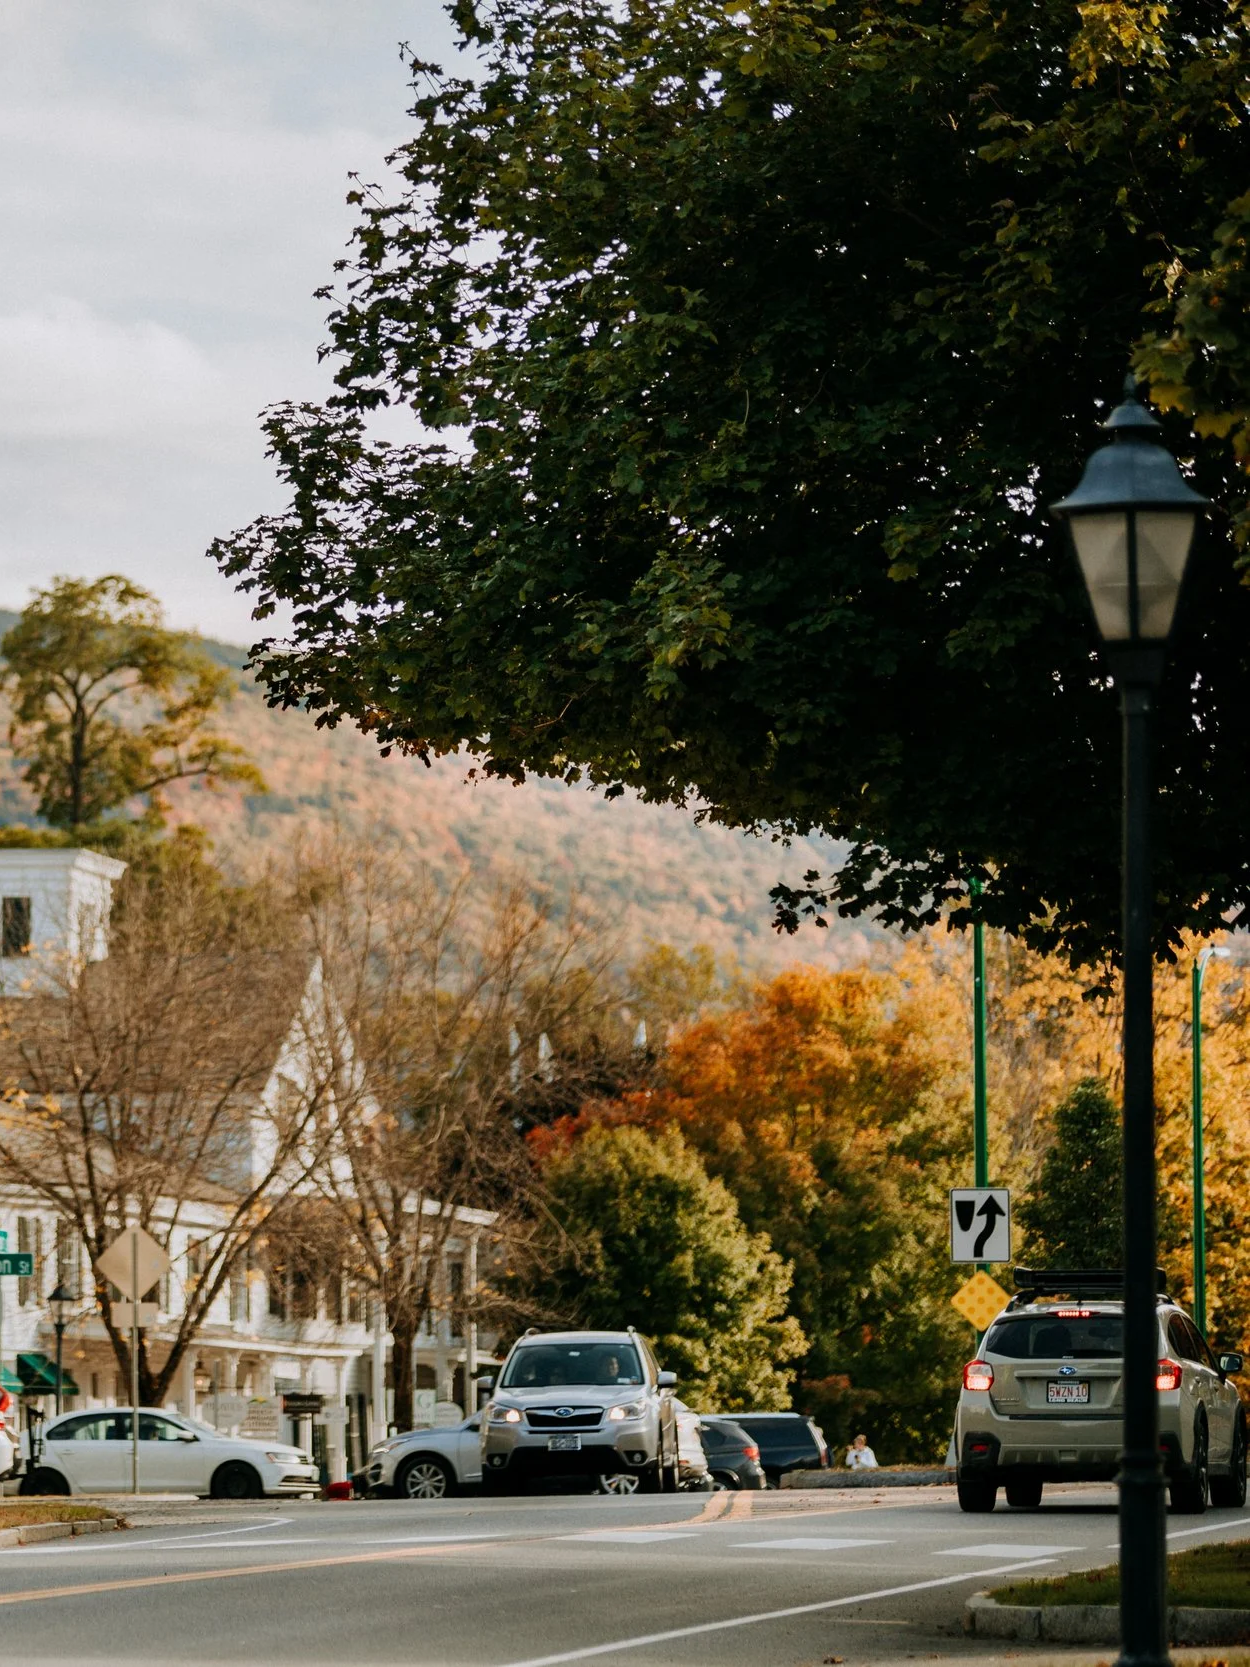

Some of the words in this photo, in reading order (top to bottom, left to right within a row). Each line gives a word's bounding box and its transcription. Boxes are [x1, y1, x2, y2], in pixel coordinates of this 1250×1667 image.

[19, 1261, 30, 1274] St
[1049, 1386, 1073, 1397] 5WZN
[1076, 1386, 1087, 1397] 10
